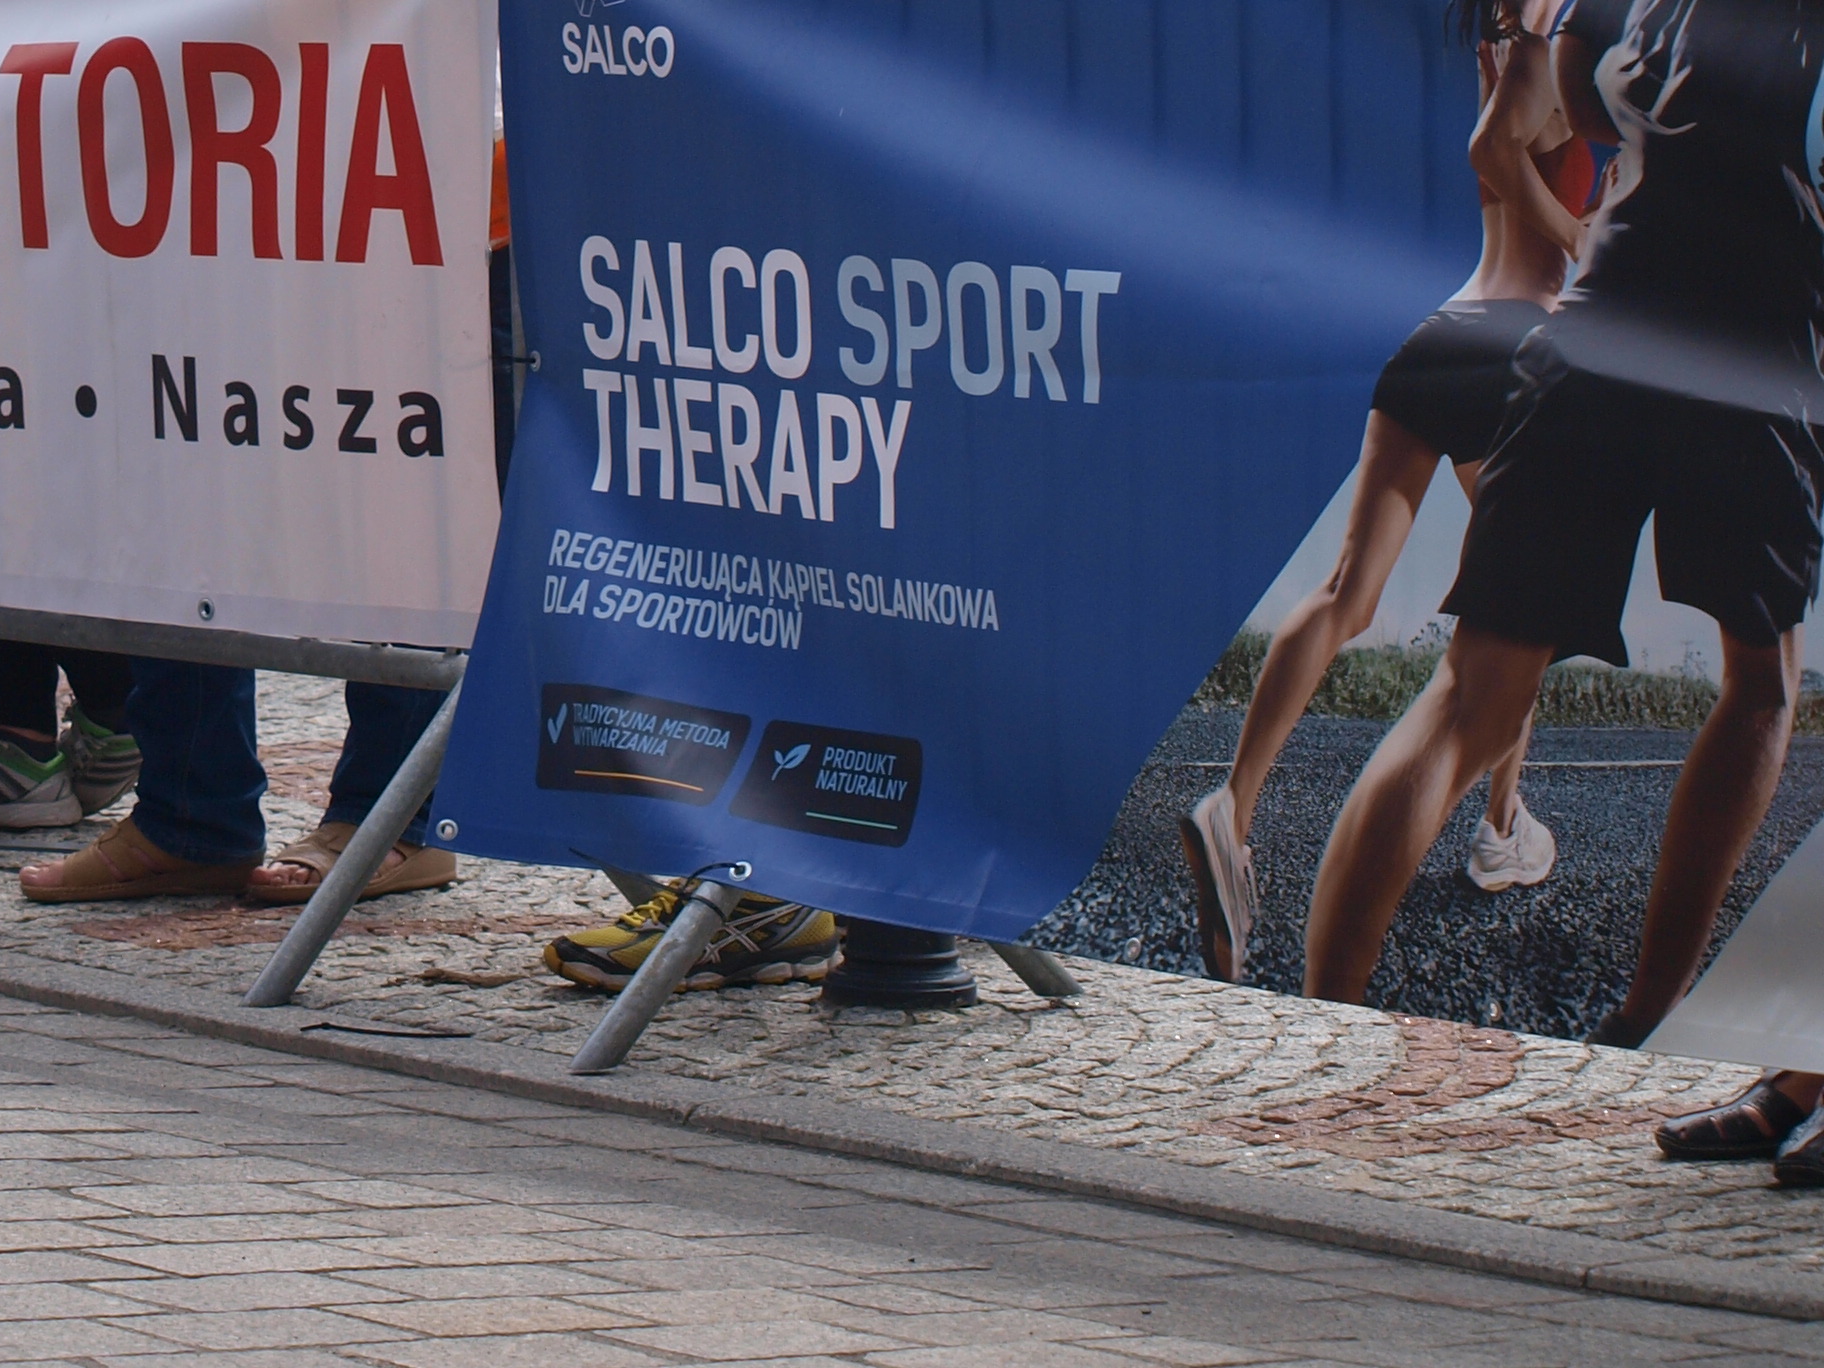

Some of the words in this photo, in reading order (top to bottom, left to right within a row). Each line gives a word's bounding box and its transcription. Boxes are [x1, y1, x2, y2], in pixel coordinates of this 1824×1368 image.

[562, 21, 675, 78] SALCO
[579, 235, 813, 380] SALCO
[836, 254, 1122, 405] SPORT
[151, 353, 445, 458] Nasza
[582, 368, 912, 530] THERAPY
[543, 575, 590, 616] DLA
[592, 584, 804, 651] SPORTOWCÓW
[548, 528, 764, 602] REGENERUJĄCA
[768, 558, 845, 612] KĄPIEL
[846, 571, 1000, 632] SOLANKOWA
[572, 702, 658, 735] TRADYCYJNA
[659, 718, 731, 750] METODA
[821, 746, 897, 777] PRODUKT
[815, 769, 908, 802] NATURALNY
